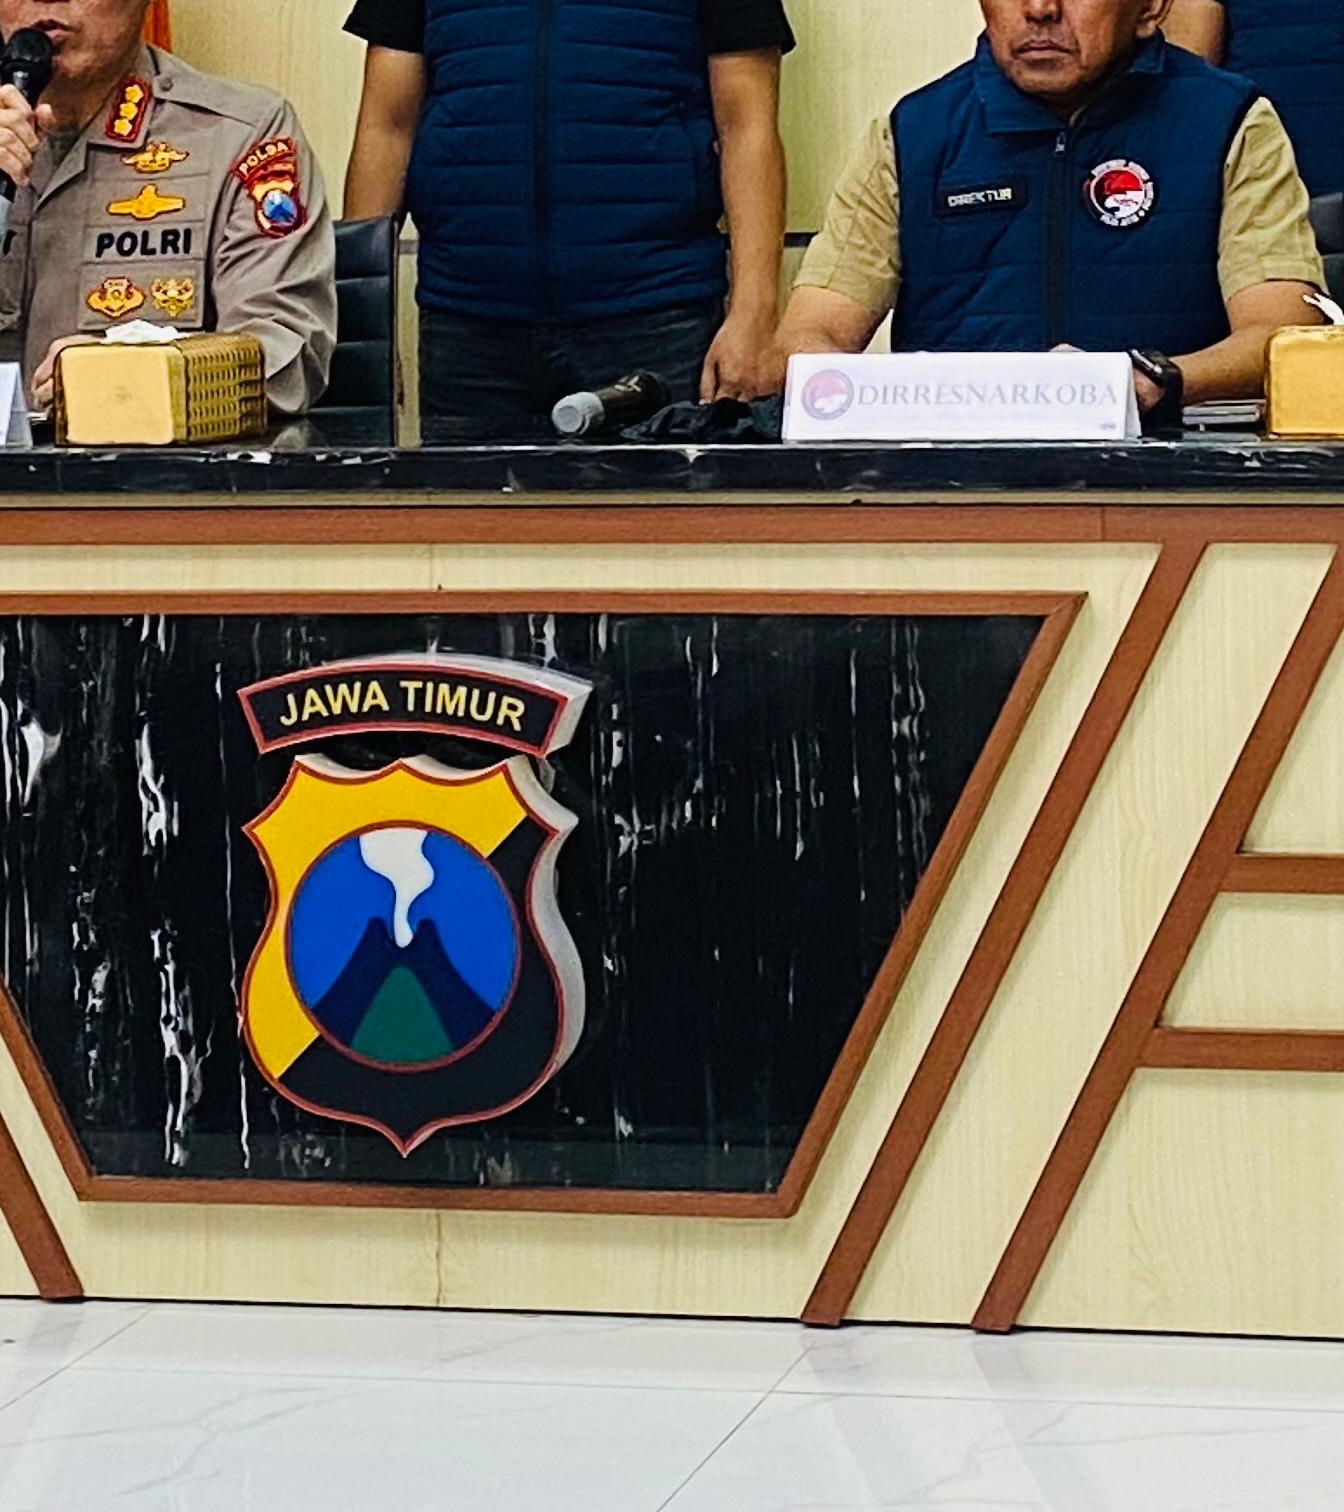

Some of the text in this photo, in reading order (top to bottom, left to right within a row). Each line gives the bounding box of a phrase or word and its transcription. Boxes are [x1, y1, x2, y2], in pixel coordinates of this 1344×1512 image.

[238, 141, 289, 175] POLDA
[94, 227, 192, 259] POLRI
[857, 382, 1119, 407] DIRRESNARKOBA
[280, 680, 526, 732] JAWA TIMUR
